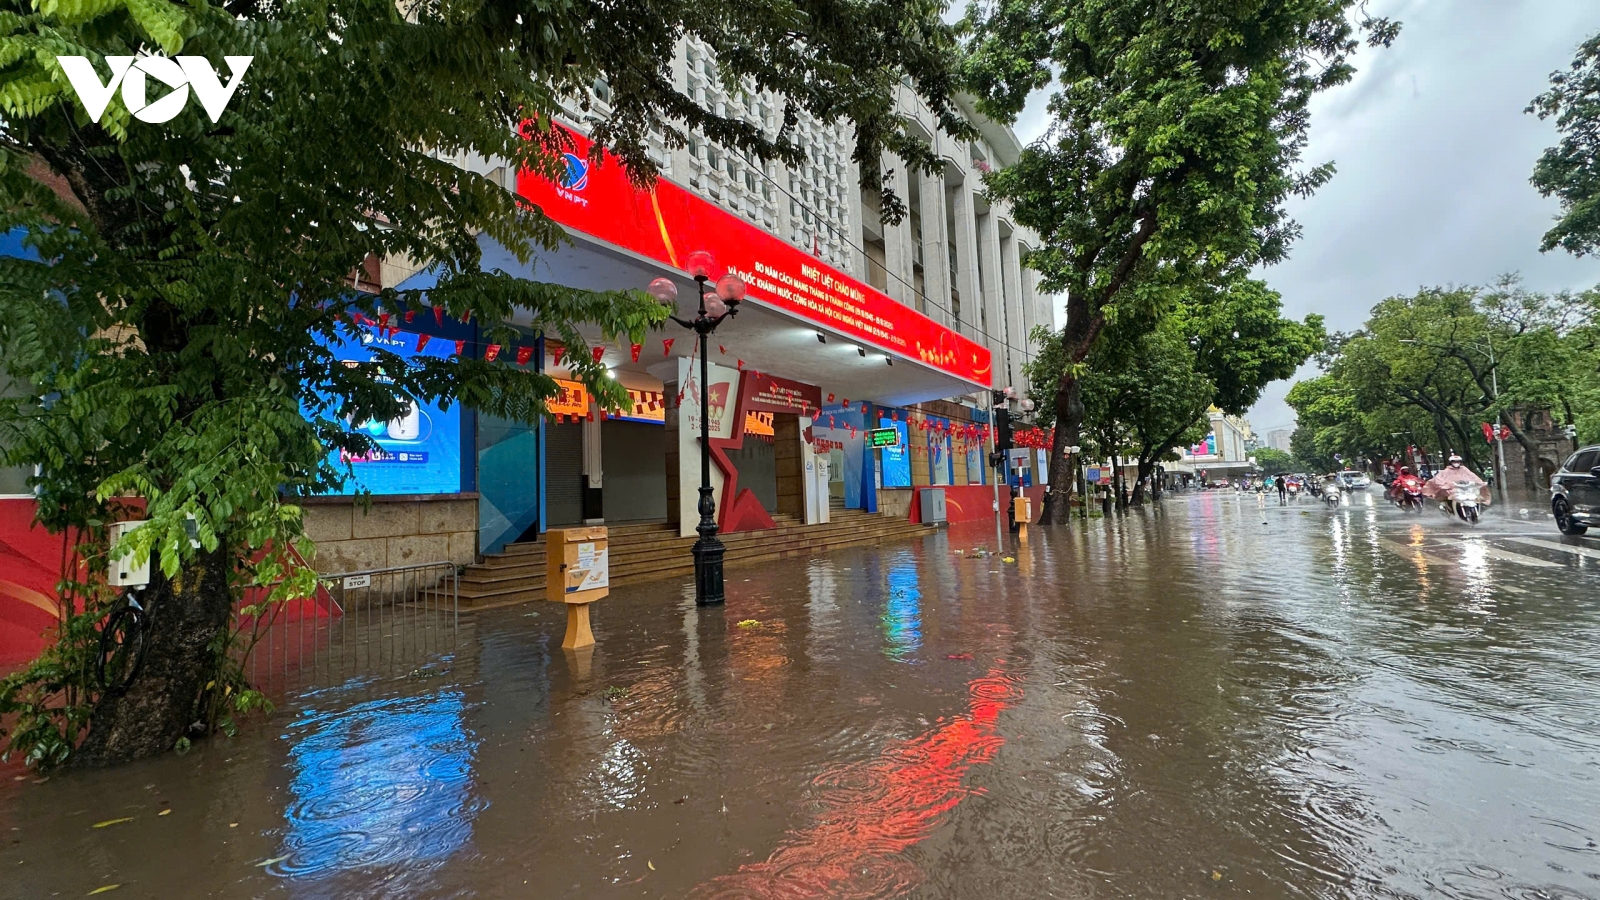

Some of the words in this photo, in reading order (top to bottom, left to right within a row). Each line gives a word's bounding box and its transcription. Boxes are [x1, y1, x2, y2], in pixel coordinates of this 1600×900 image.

[556, 187, 588, 207] VNPT
[755, 261, 765, 273] 80
[765, 265, 779, 280] NĂM
[778, 271, 793, 287] CÁCH
[793, 278, 809, 293] MẠNG
[809, 285, 825, 301] THÁNG
[829, 294, 844, 309] THÀNH
[843, 301, 855, 314] CÔNG
[801, 263, 820, 283] NHIỆT
[821, 273, 834, 290] LIỆT
[834, 280, 850, 297] CHÀO
[850, 287, 866, 304] MỪNG
[727, 265, 737, 276] VÀ
[738, 269, 756, 287] QUỐC
[756, 278, 777, 295] KHÁNH
[777, 286, 793, 301] NƯỚC
[793, 293, 808, 307] CỘNG
[807, 298, 818, 311] HÒA
[817, 303, 825, 314] XÃ
[824, 306, 833, 318] HỘI
[833, 310, 842, 321] CHỦ
[863, 322, 873, 333] NAM
[376, 337, 406, 347] VNPT
[687, 415, 695, 423] 19
[706, 418, 721, 426] 1945
[707, 404, 724, 419] 80
